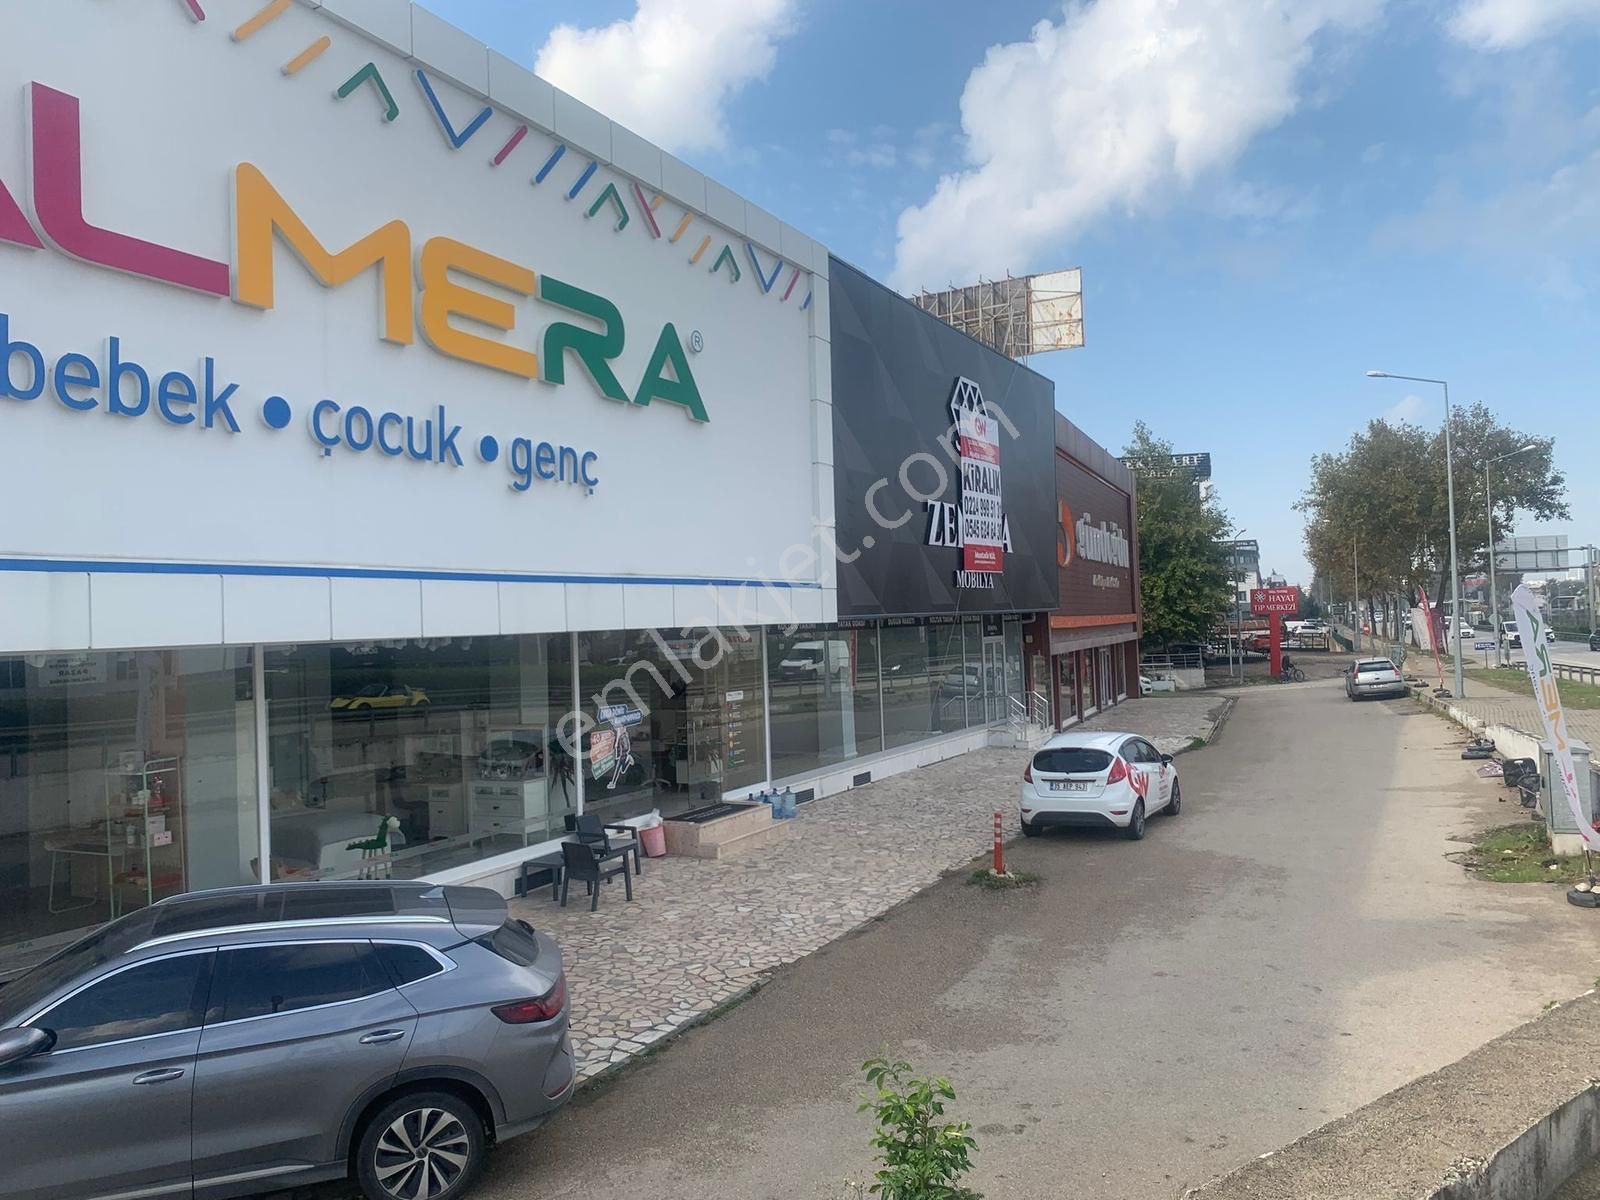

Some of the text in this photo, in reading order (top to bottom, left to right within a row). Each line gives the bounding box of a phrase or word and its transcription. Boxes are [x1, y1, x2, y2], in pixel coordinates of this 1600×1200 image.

[0, 81, 711, 424] LMERA
[0, 312, 600, 497] bebek çocuk genç
[964, 495, 979, 516] 0224
[964, 518, 979, 539] 0545
[1268, 594, 1296, 603] HAYAT
